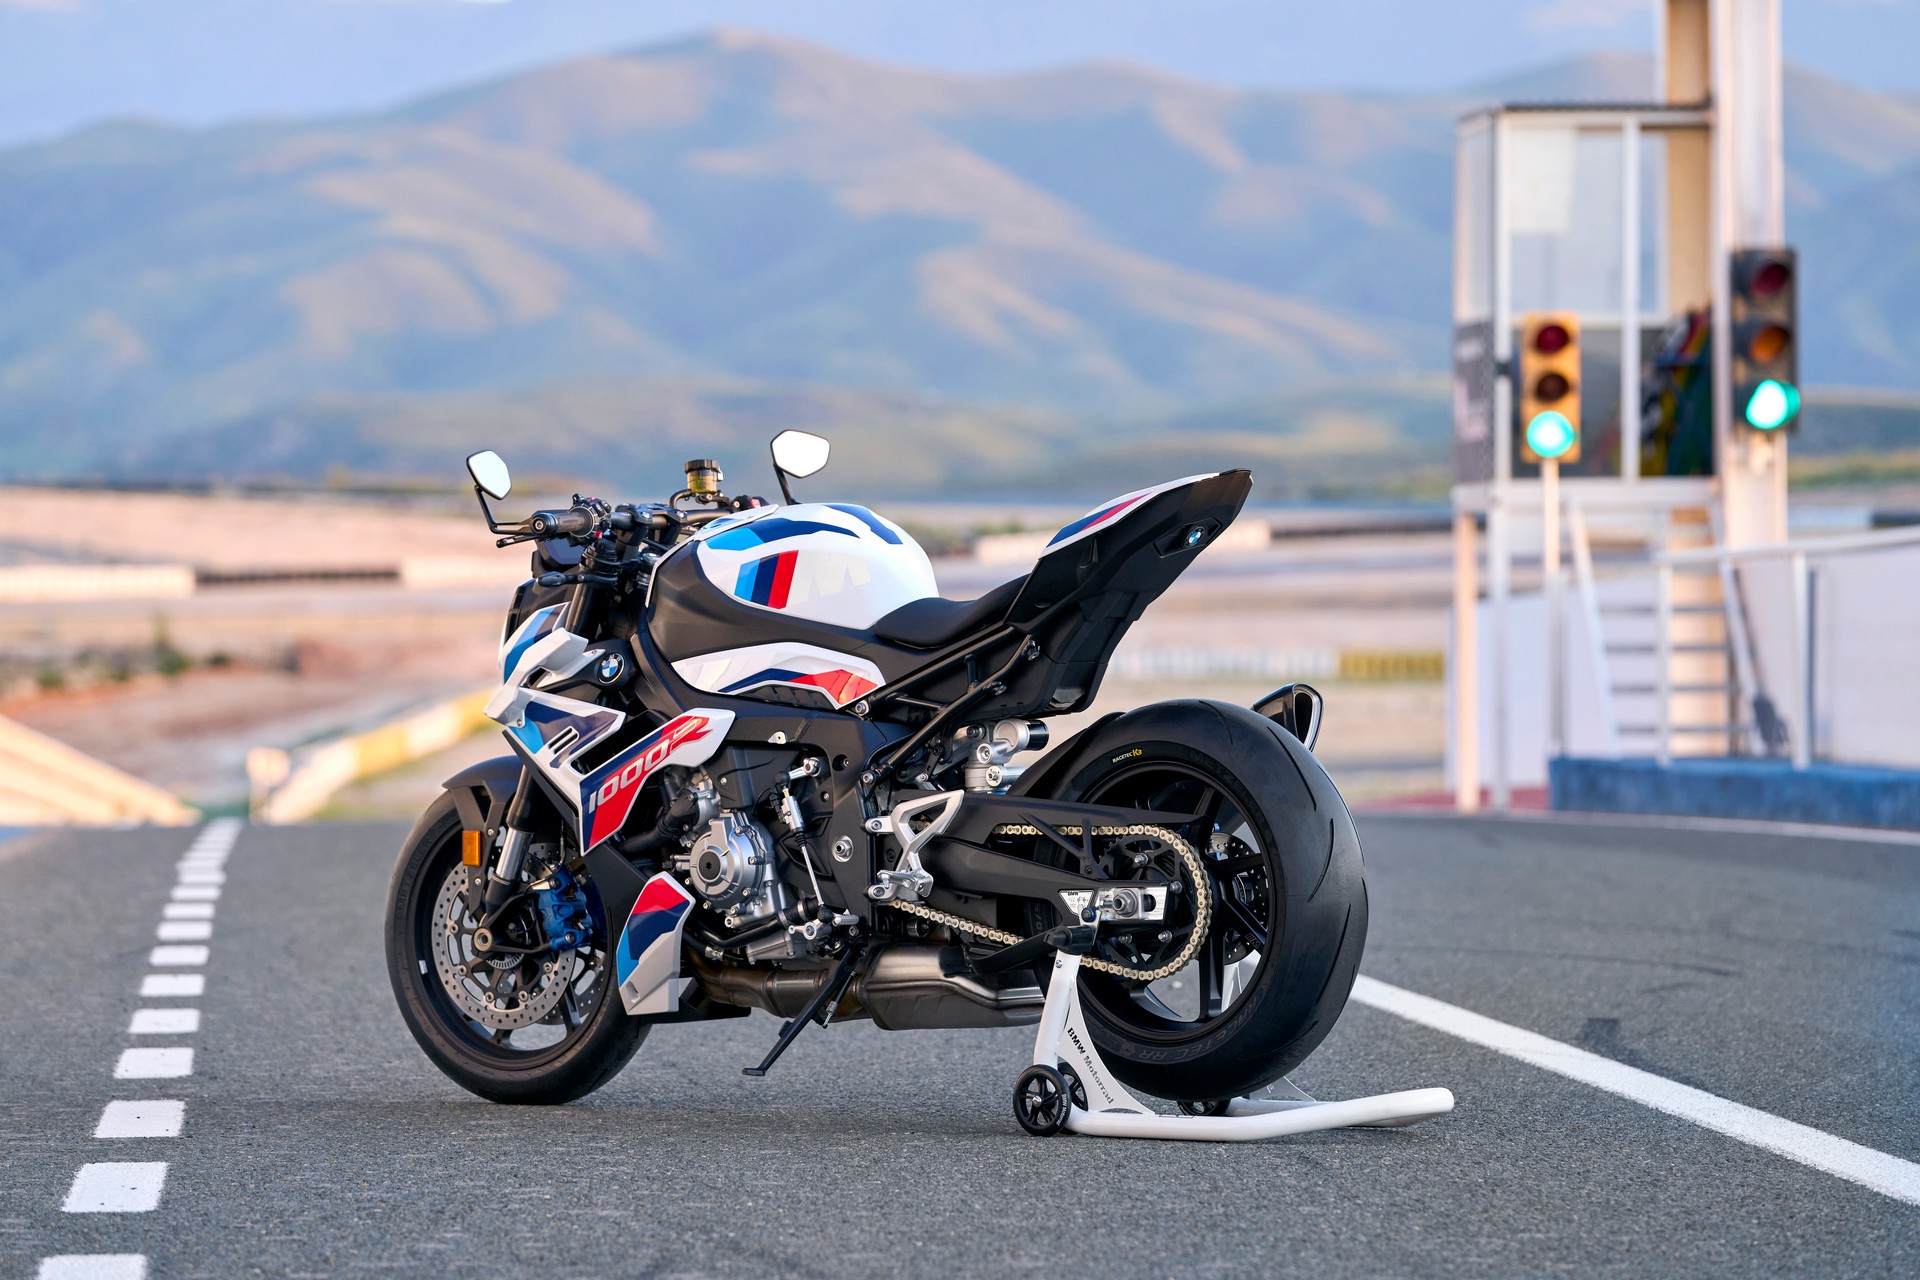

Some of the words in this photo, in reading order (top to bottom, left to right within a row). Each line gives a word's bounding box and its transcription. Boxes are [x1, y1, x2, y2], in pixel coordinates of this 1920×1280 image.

[1132, 748, 1143, 757] K3
[1067, 1027, 1086, 1054] BMW
[1083, 1055, 1114, 1104] Motorrad
